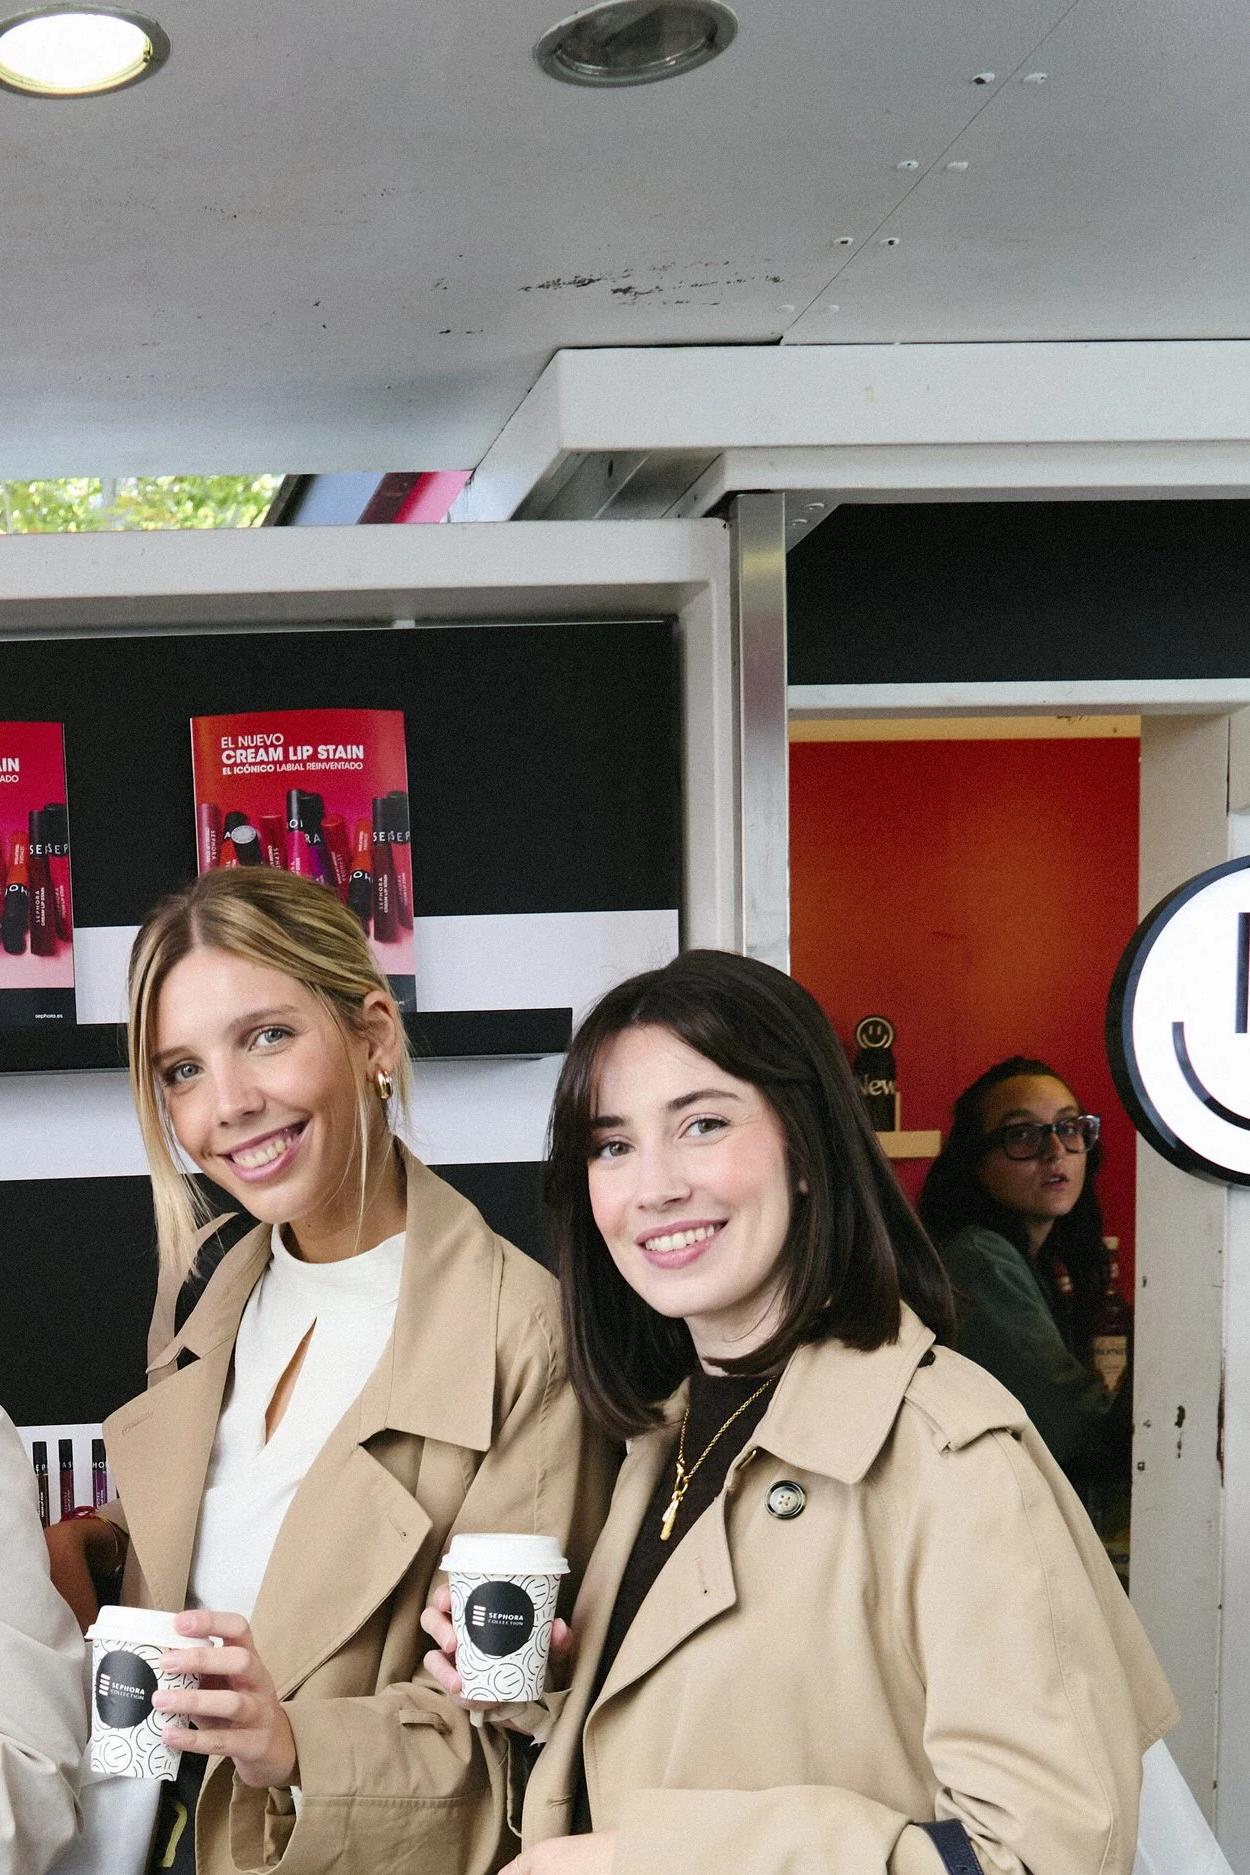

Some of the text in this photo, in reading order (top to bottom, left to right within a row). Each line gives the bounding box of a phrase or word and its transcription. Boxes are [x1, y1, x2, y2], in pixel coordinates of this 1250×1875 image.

[221, 734, 284, 749] EL NUEVO
[221, 744, 364, 765] CREAM LIP STAIN
[222, 761, 363, 775] EL ICÓNICO LABIAL REINVENTADO
[488, 1612, 524, 1621] SEPHORA
[110, 1689, 145, 1701] COLLECTION
[111, 1682, 145, 1695] SEPHORA
